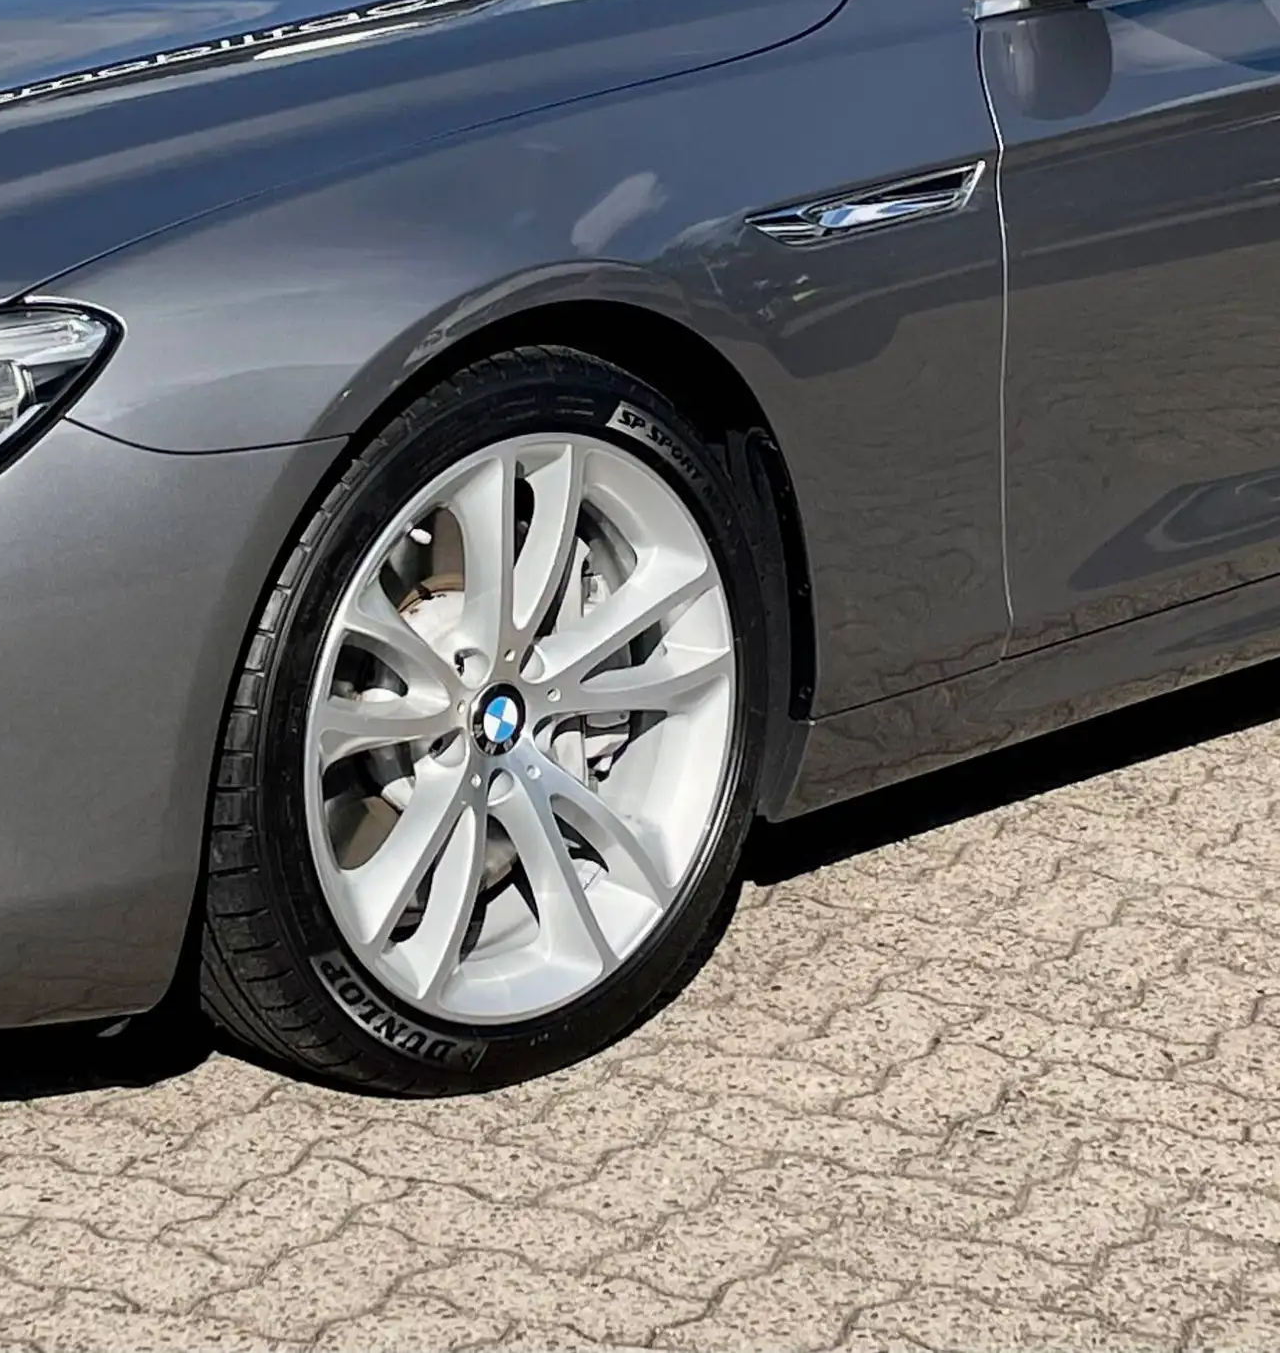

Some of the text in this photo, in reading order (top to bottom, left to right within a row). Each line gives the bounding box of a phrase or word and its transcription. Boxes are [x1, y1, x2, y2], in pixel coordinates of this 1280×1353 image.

[617, 409, 705, 480] SP SPORT
[320, 960, 458, 1063] DUNLOP
